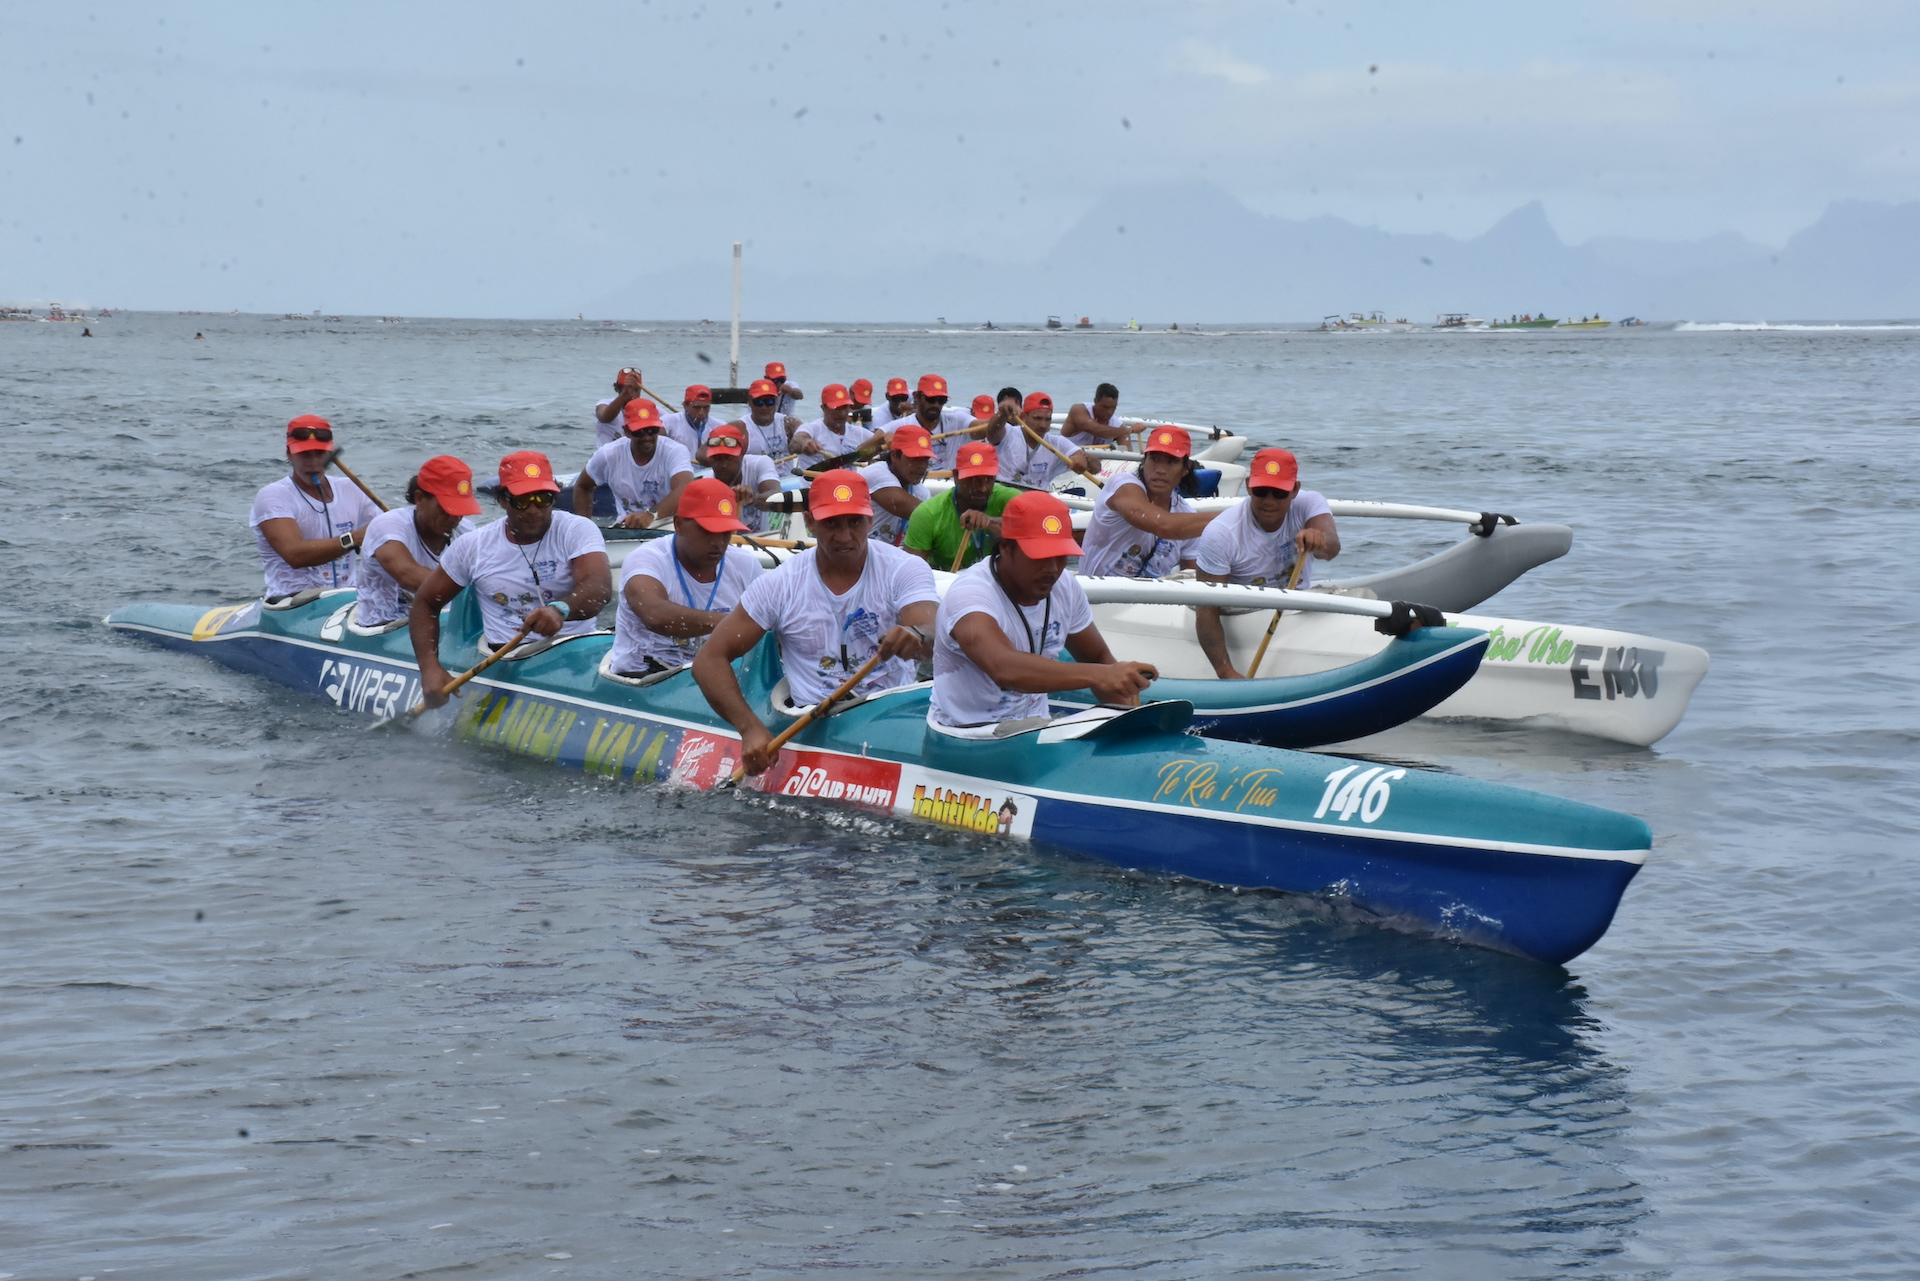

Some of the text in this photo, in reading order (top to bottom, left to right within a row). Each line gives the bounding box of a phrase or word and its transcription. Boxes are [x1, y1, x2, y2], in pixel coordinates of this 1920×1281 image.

[348, 665, 406, 718] VIPER
[845, 783, 893, 807] TAHITI
[1152, 759, 1196, 801] Te
[1180, 762, 1218, 807] Ra
[1236, 768, 1285, 812] Tua
[1313, 764, 1406, 823] 146
